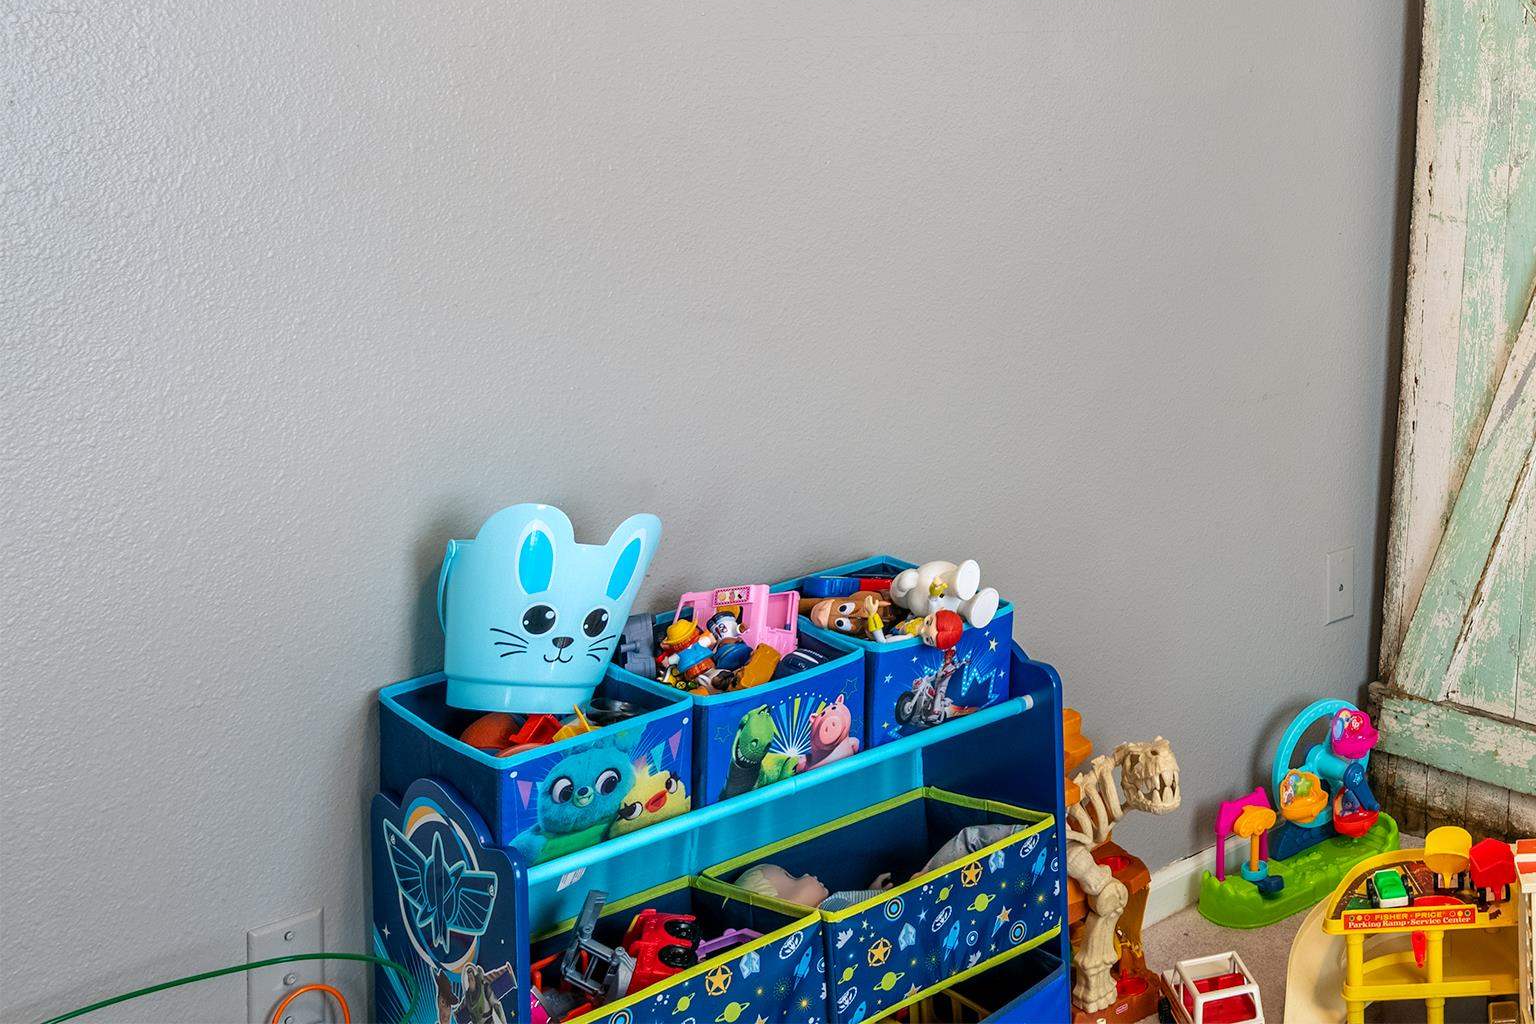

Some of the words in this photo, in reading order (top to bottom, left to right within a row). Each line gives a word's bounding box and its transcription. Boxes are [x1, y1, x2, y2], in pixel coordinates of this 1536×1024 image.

[1374, 913, 1408, 921] FISHER
[1414, 911, 1443, 919] PRICE
[1348, 920, 1382, 929] Parking
[1410, 918, 1441, 926] Service
[1443, 916, 1471, 924] Center
